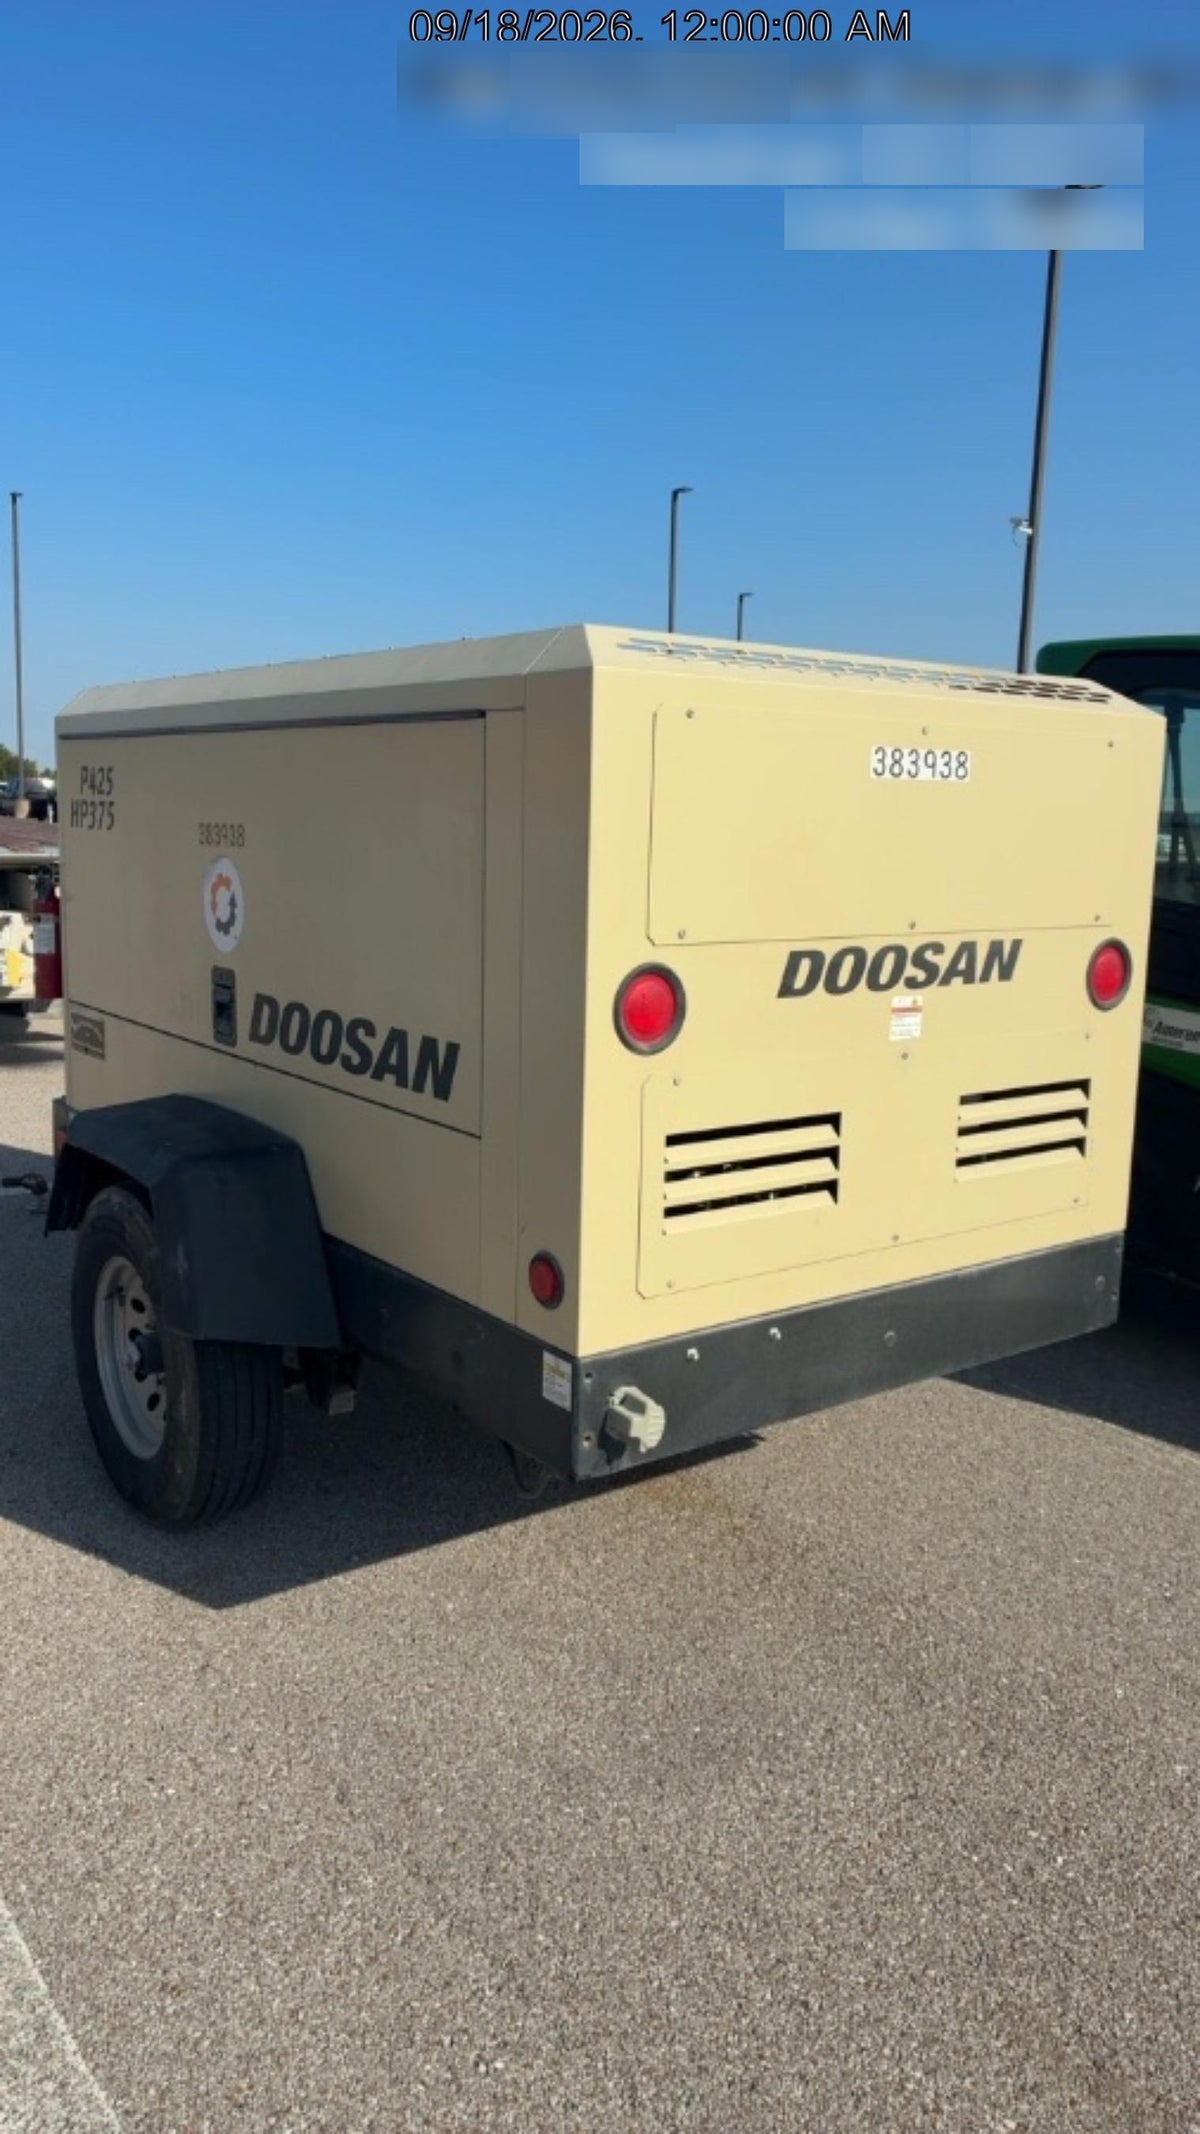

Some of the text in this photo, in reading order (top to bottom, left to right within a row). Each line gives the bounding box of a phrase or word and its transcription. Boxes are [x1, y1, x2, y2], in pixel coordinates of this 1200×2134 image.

[872, 746, 969, 780] 383938
[79, 765, 115, 796] P425
[70, 799, 116, 830] HP375
[198, 822, 247, 847] 383938
[777, 938, 1023, 999] DOOSAN
[249, 992, 461, 1103] DOOSAN
